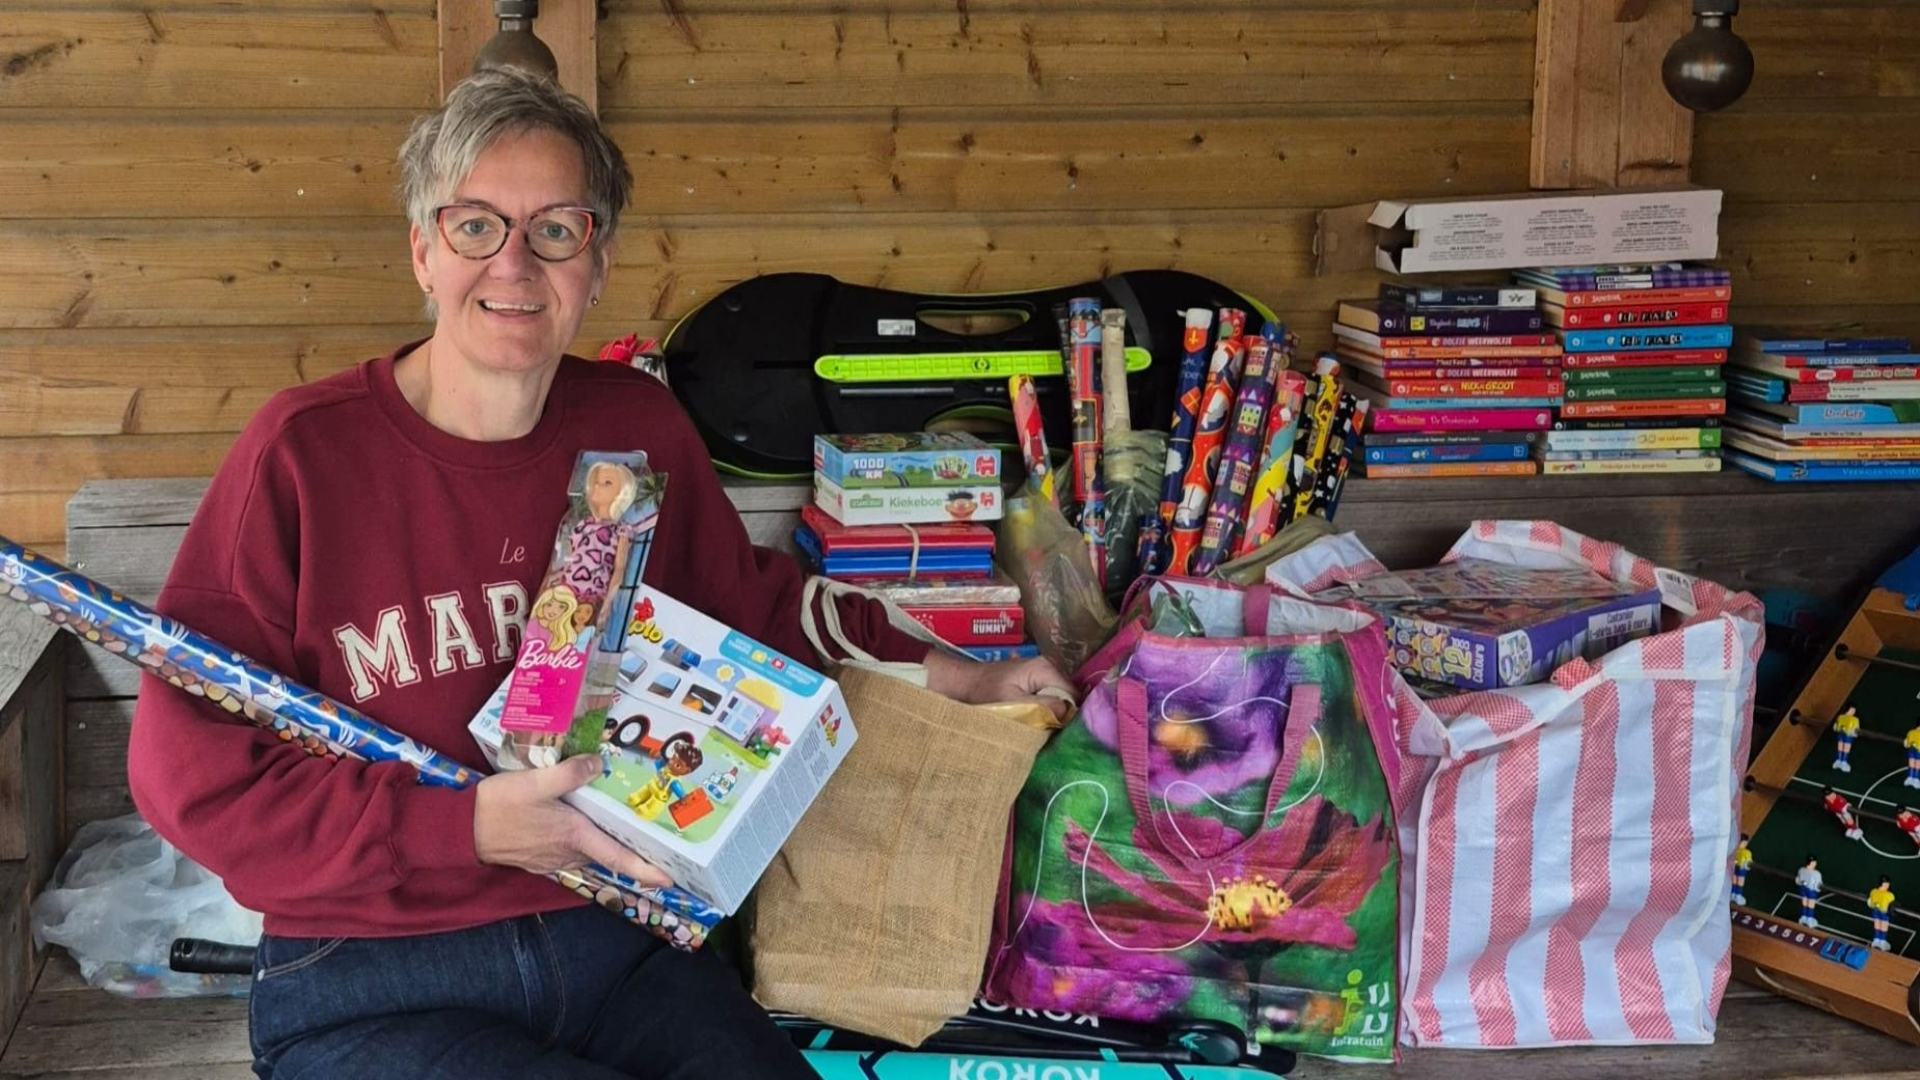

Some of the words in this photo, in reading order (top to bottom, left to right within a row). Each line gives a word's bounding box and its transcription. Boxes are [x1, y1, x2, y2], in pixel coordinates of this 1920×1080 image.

[853, 457, 885, 470] 1000
[865, 469, 883, 479] KM
[889, 495, 942, 507] Kiekeboe
[499, 538, 525, 565] Le
[333, 580, 530, 703] MAR
[627, 619, 664, 644] plo
[972, 623, 1006, 635] RUMMY
[517, 639, 584, 669] Barbie
[1443, 645, 1472, 680] 12
[1741, 915, 1752, 925] 2
[1755, 919, 1765, 929] 3
[1768, 924, 1779, 934] 4
[1781, 928, 1792, 939] 5
[1795, 933, 1805, 943] 6
[1809, 937, 1820, 947] 7
